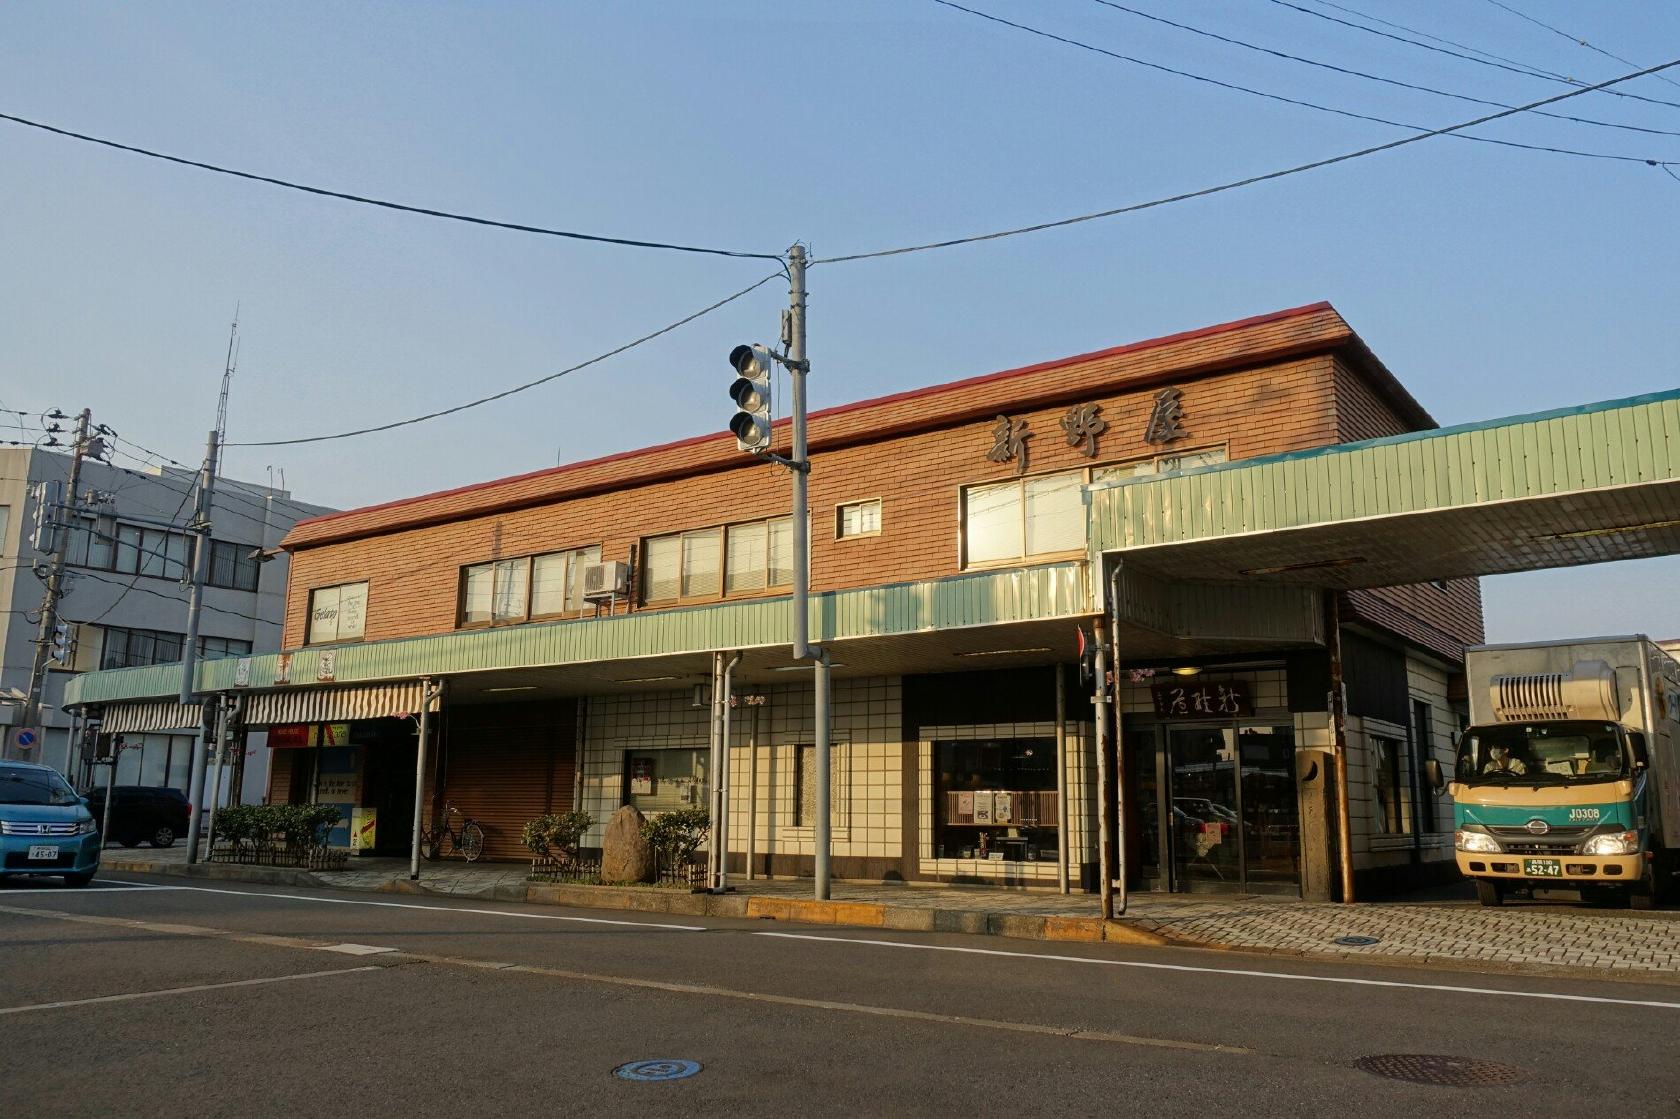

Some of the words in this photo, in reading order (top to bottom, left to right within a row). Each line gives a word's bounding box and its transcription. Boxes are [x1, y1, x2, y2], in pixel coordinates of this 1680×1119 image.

[986, 386, 1190, 474] 新野屋
[1569, 808, 1600, 819] J0308
[1531, 865, 1559, 875] 52-47
